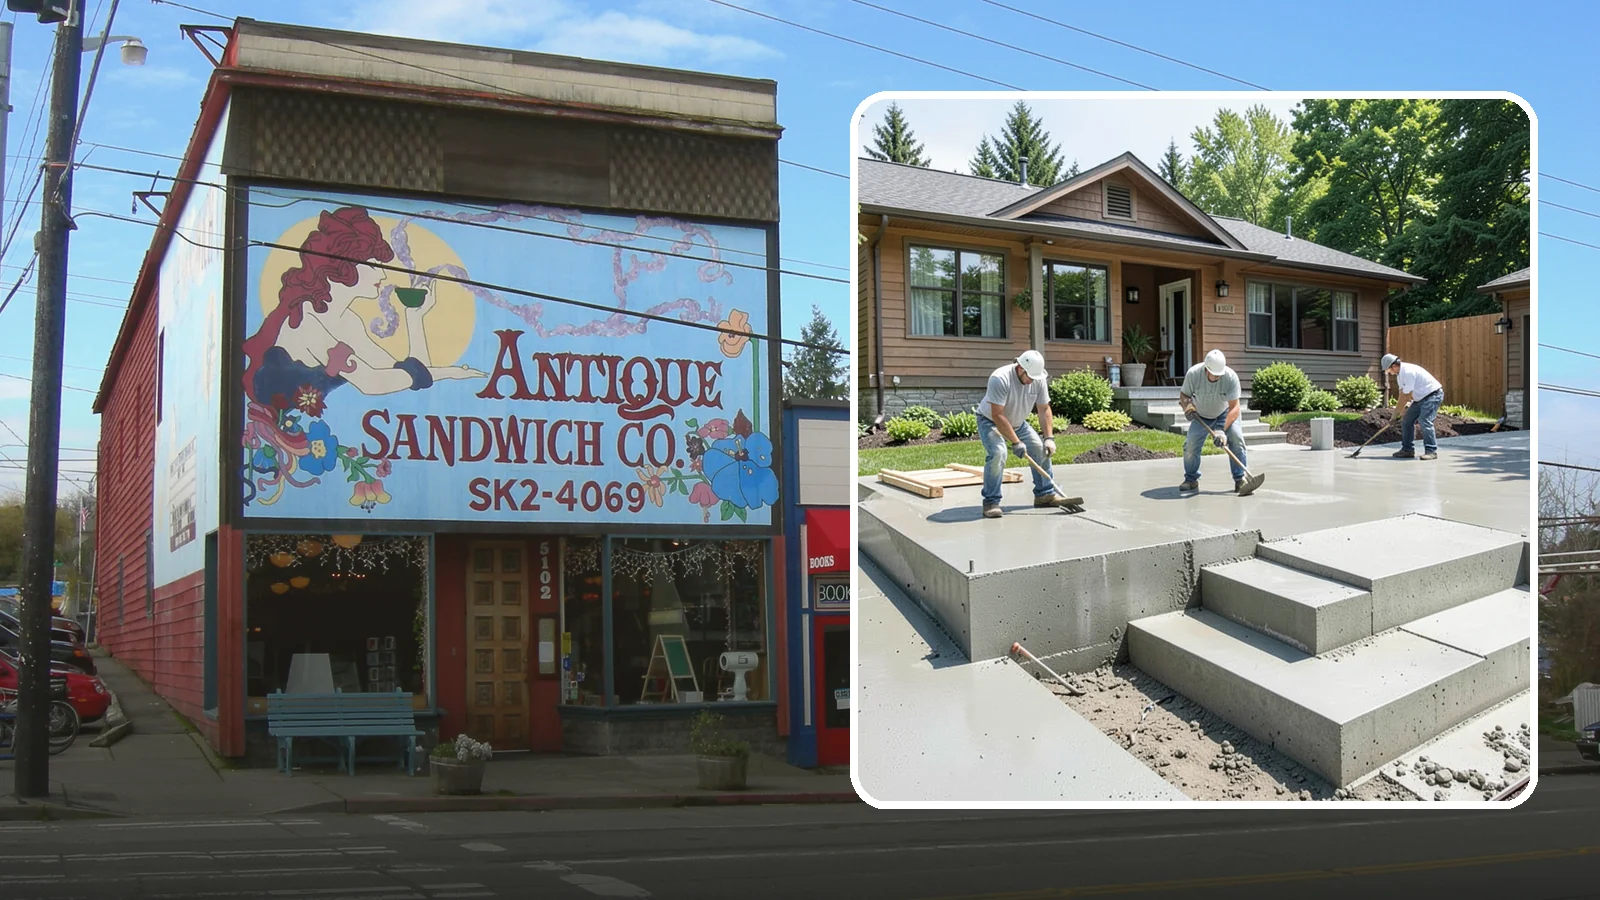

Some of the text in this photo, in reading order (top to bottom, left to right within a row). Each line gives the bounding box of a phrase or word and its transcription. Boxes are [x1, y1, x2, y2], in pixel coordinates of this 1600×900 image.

[475, 329, 723, 420] ANTIQUE
[361, 408, 685, 469] SANDWICH CO.
[468, 476, 645, 513] SK2-4069
[540, 542, 552, 599] 5102
[809, 555, 835, 569] BOOKS
